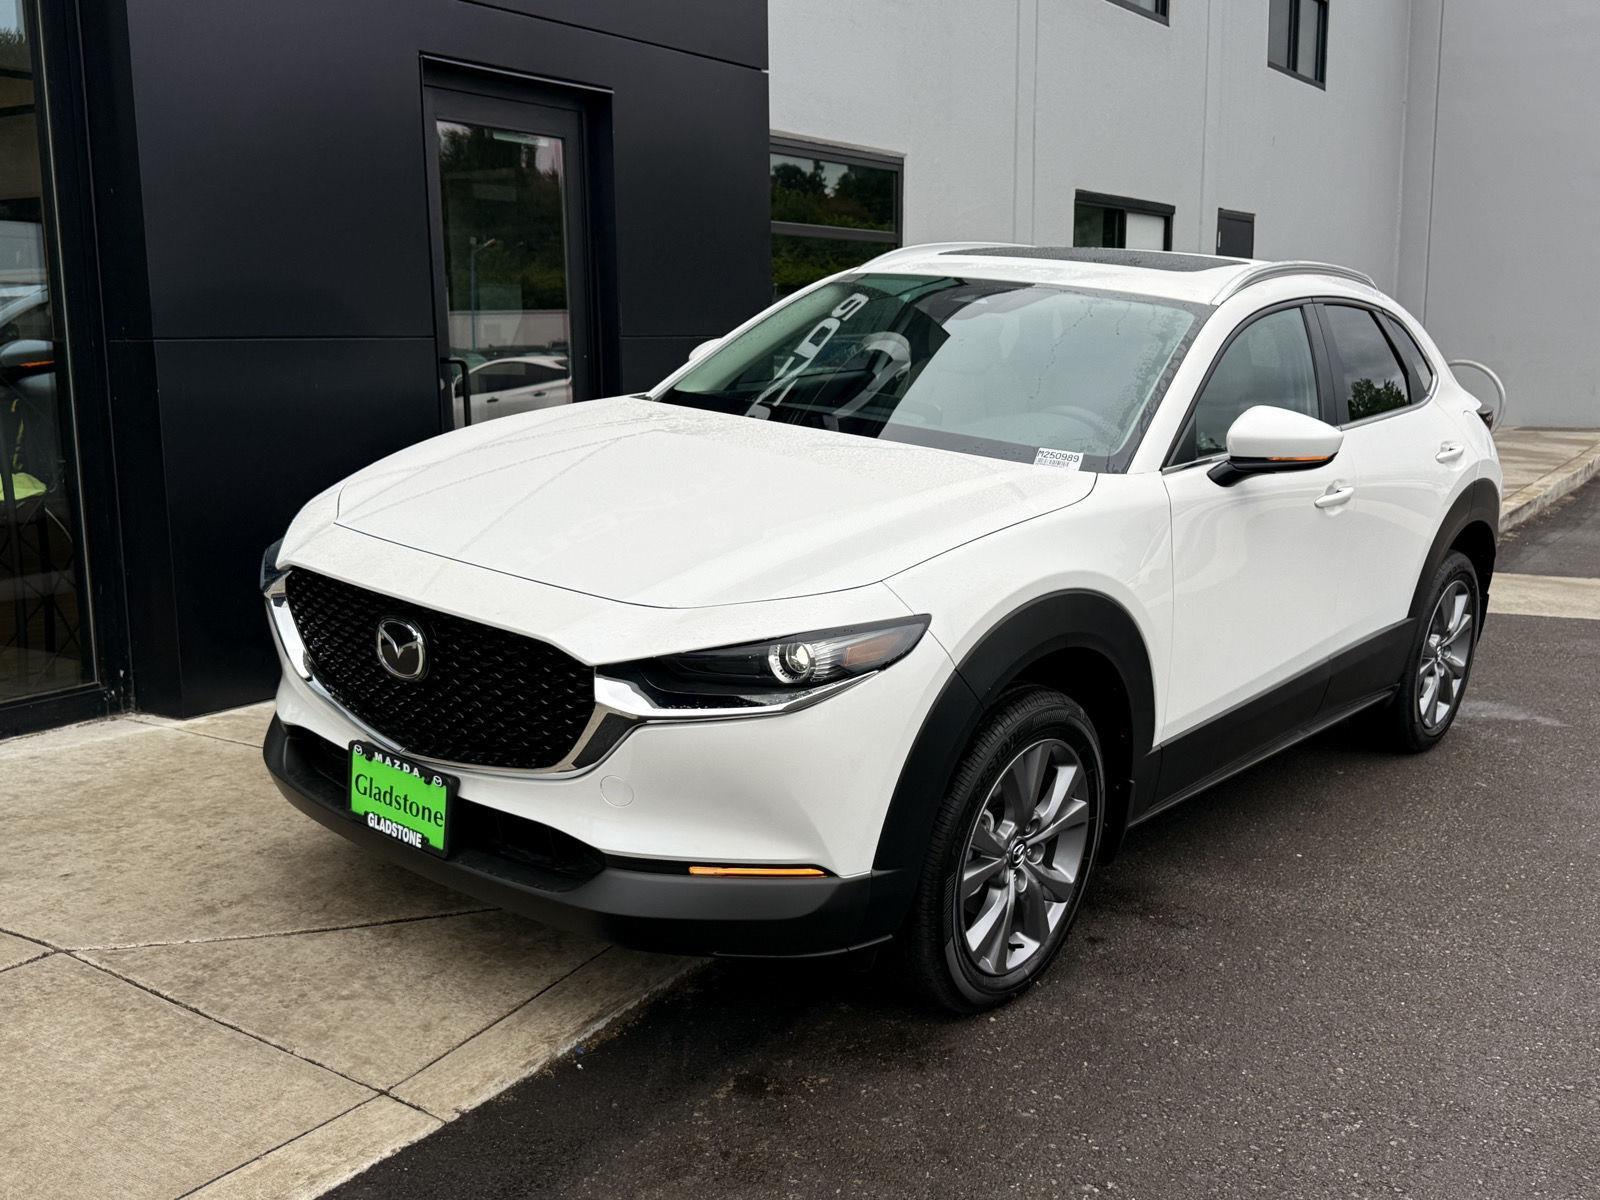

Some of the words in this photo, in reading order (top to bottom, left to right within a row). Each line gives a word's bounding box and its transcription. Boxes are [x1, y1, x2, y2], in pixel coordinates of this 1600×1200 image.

[1037, 450, 1080, 463] M250989
[374, 752, 421, 778] MAZDA
[354, 773, 444, 828] Gladstone
[367, 812, 422, 849] GLADSTONE
